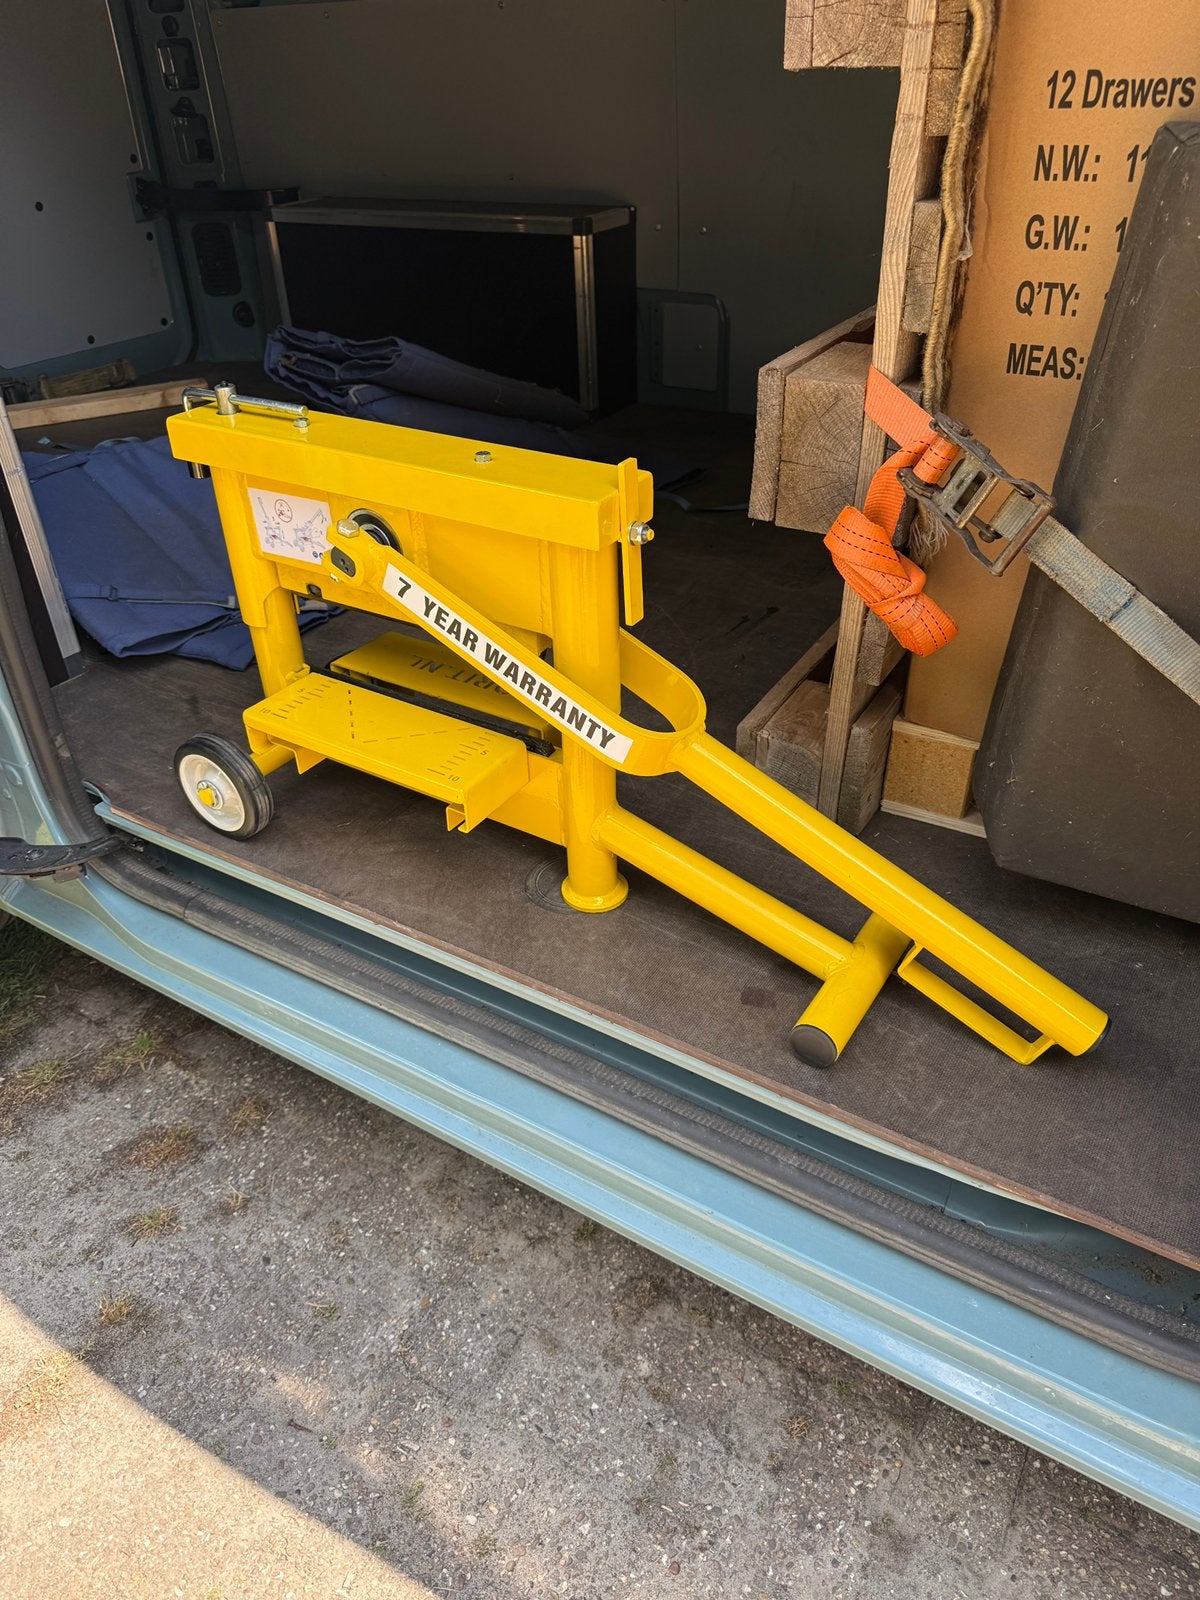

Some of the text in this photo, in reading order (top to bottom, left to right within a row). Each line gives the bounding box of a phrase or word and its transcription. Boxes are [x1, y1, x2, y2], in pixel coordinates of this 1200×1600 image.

[1046, 69, 1196, 109] 12 Drawers
[1033, 144, 1101, 182] N.W.:
[1024, 214, 1091, 252] G.W.:
[1015, 280, 1080, 317] Q'TY:
[1006, 342, 1085, 380] MEAS:
[396, 576, 616, 750] 7 YEAR WARRANTY
